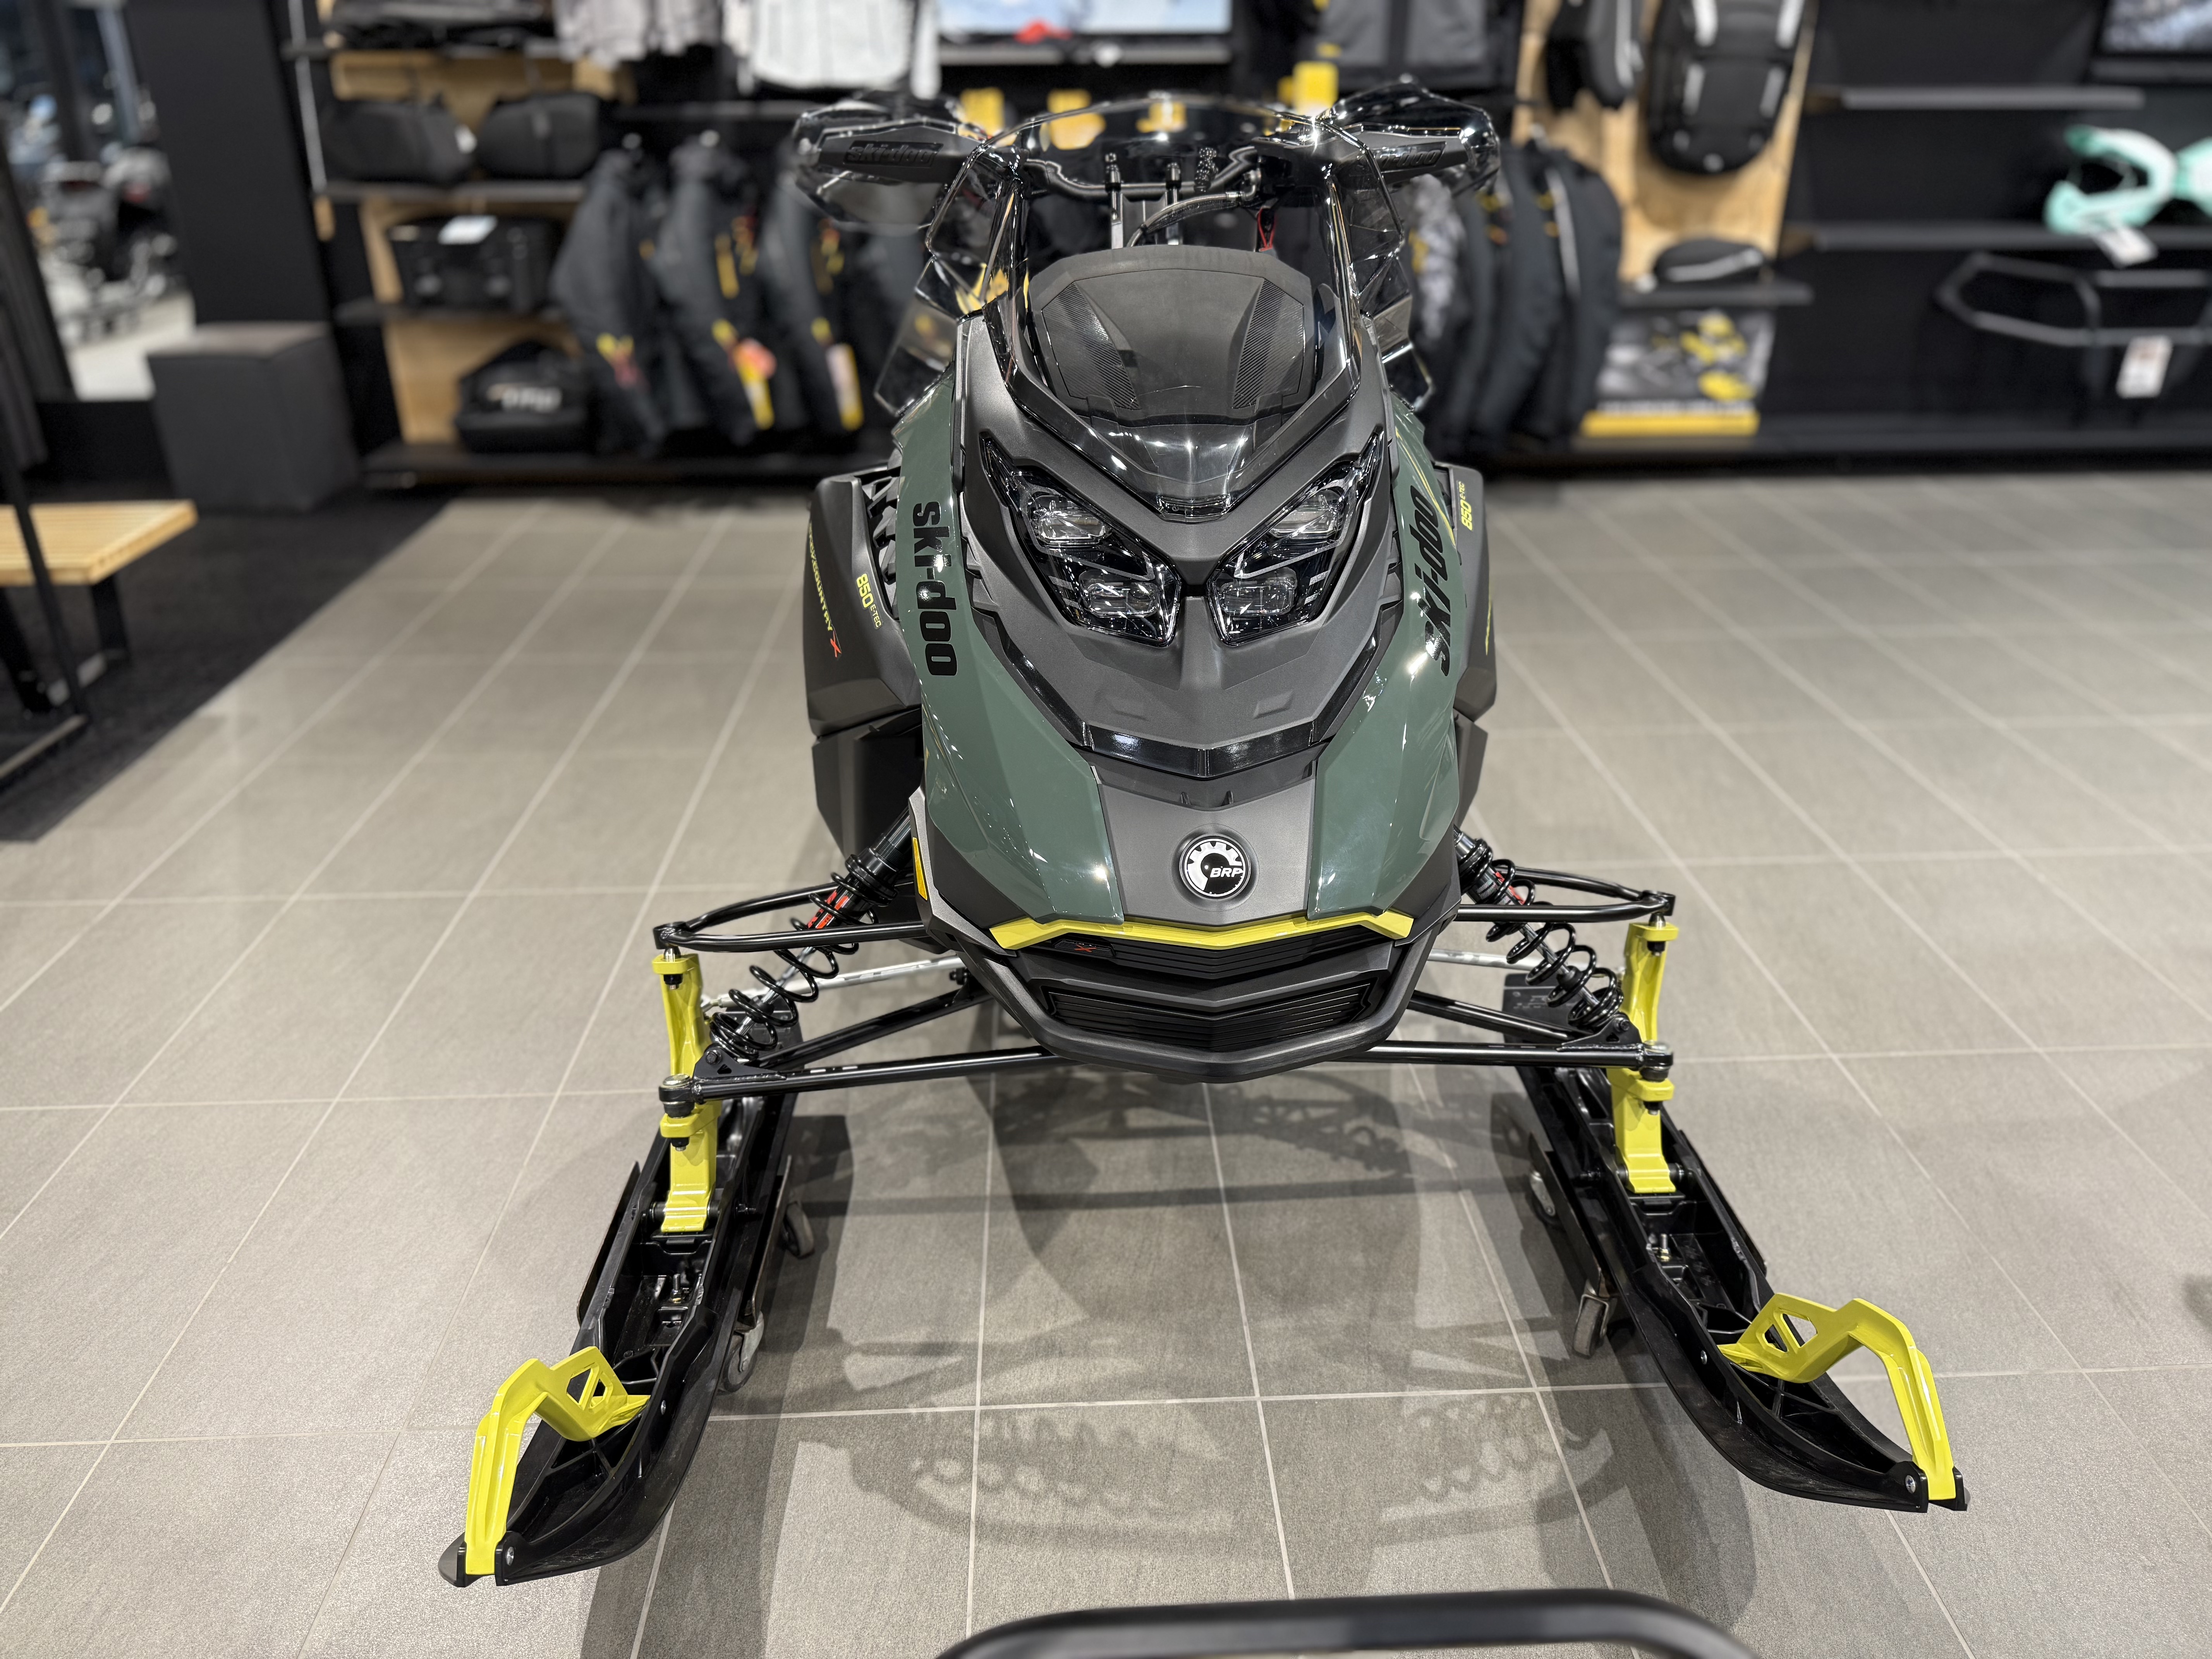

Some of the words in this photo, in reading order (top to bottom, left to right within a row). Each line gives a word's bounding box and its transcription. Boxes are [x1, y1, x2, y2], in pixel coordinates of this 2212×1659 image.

[847, 144, 937, 163] ski-doo
[1460, 499, 1473, 531] 850
[856, 573, 874, 608] 850
[870, 604, 882, 628] E-TEC
[913, 501, 957, 676] ski-doo
[1210, 867, 1243, 878] BRP
